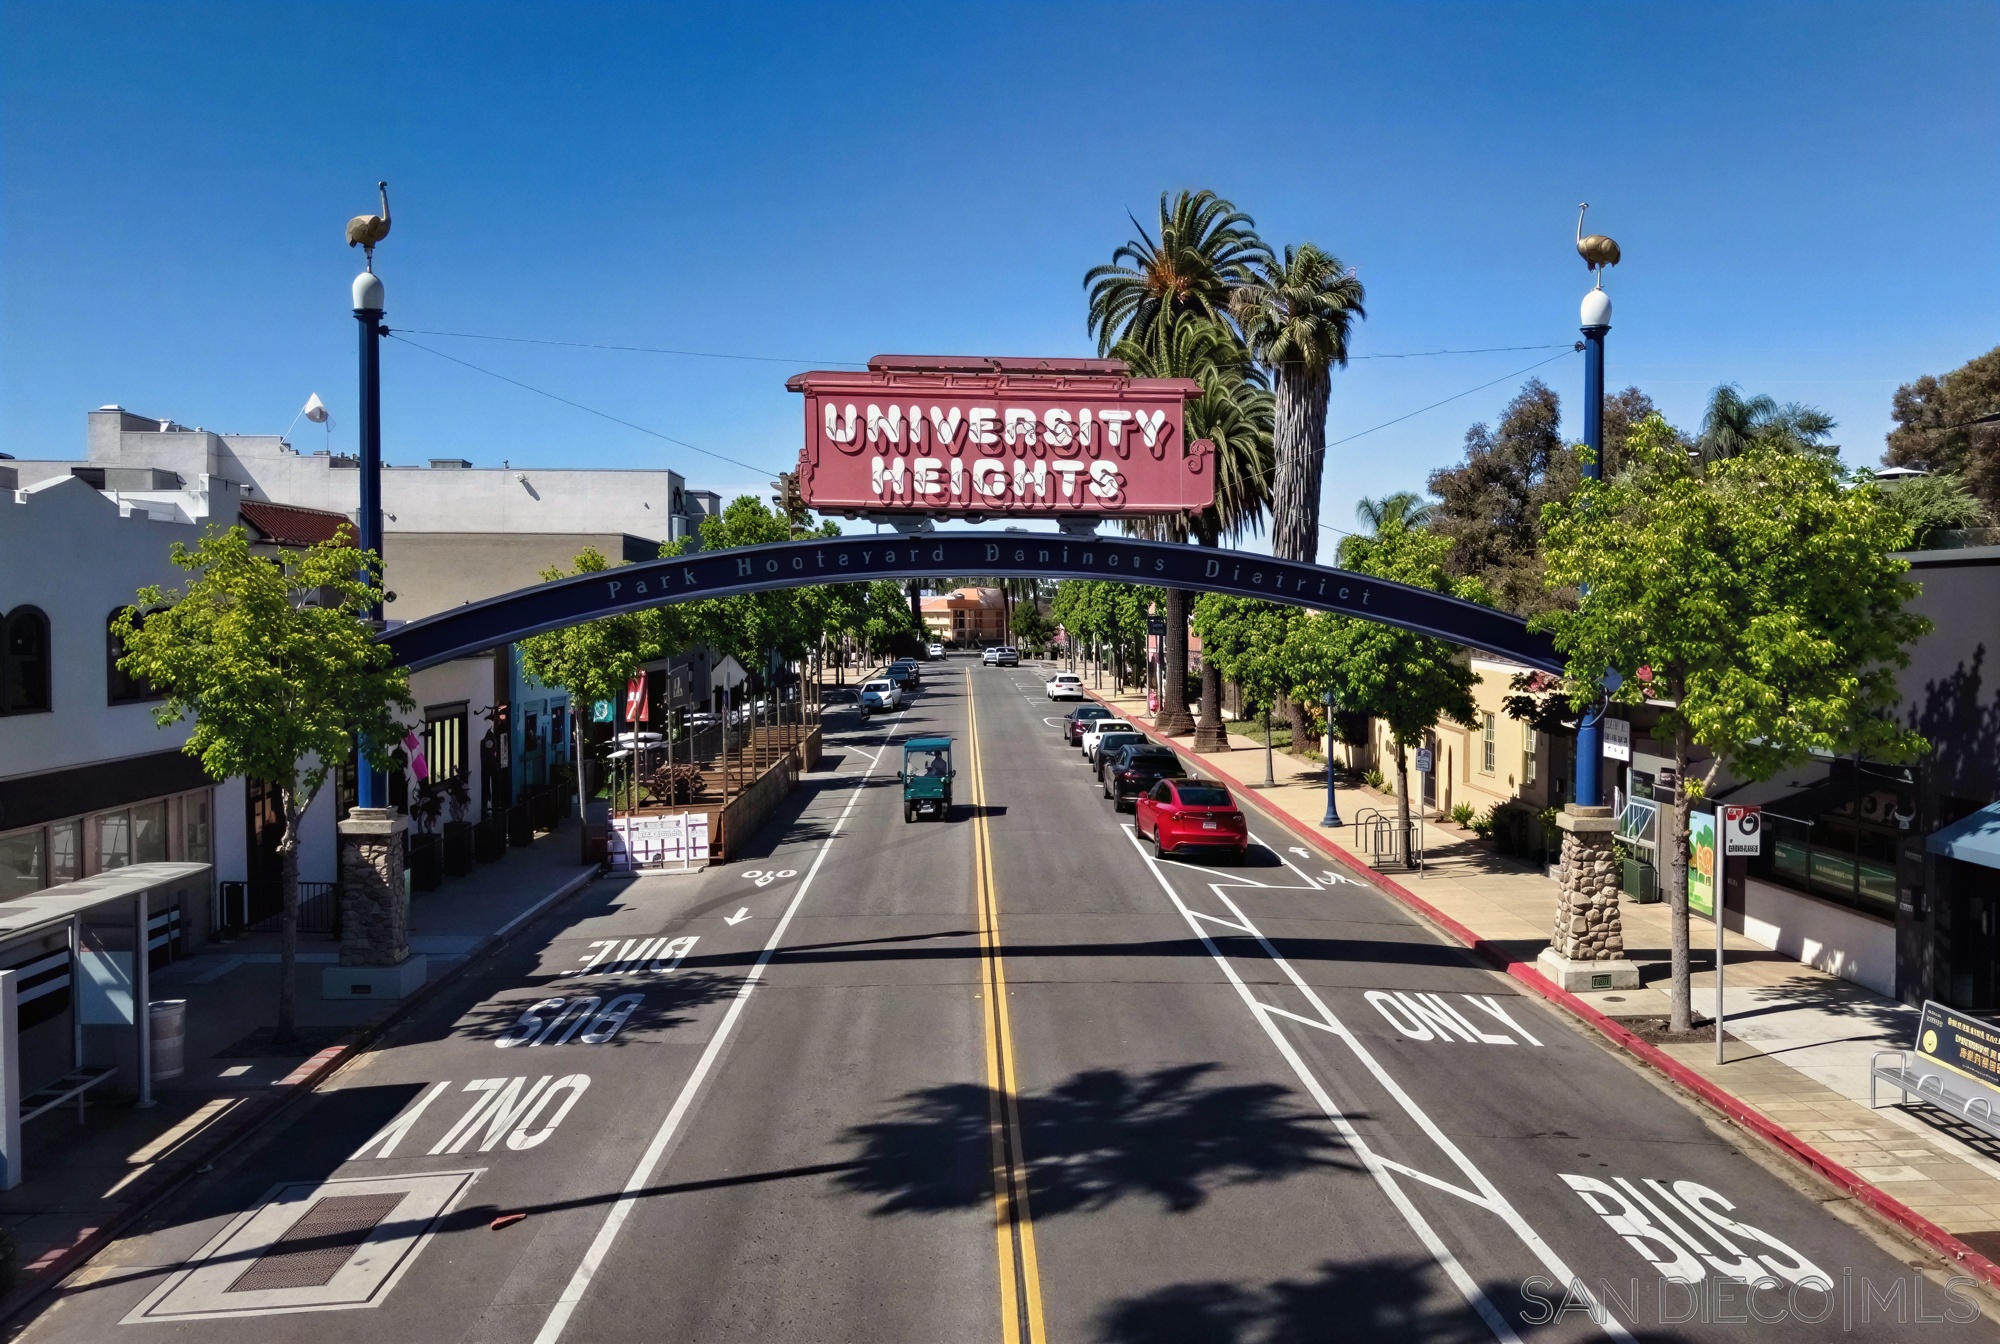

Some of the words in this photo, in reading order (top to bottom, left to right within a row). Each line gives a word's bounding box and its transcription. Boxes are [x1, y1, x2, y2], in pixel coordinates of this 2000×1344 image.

[824, 402, 1168, 450] UNIVERSITY
[871, 455, 1120, 499] HEIGHTS
[608, 567, 697, 599] Park
[559, 935, 700, 978] BIKE
[494, 993, 646, 1048] BUS
[1363, 990, 1545, 1047] ONLY
[347, 1073, 591, 1161] ONLY
[1557, 1173, 1834, 1292] BUS
